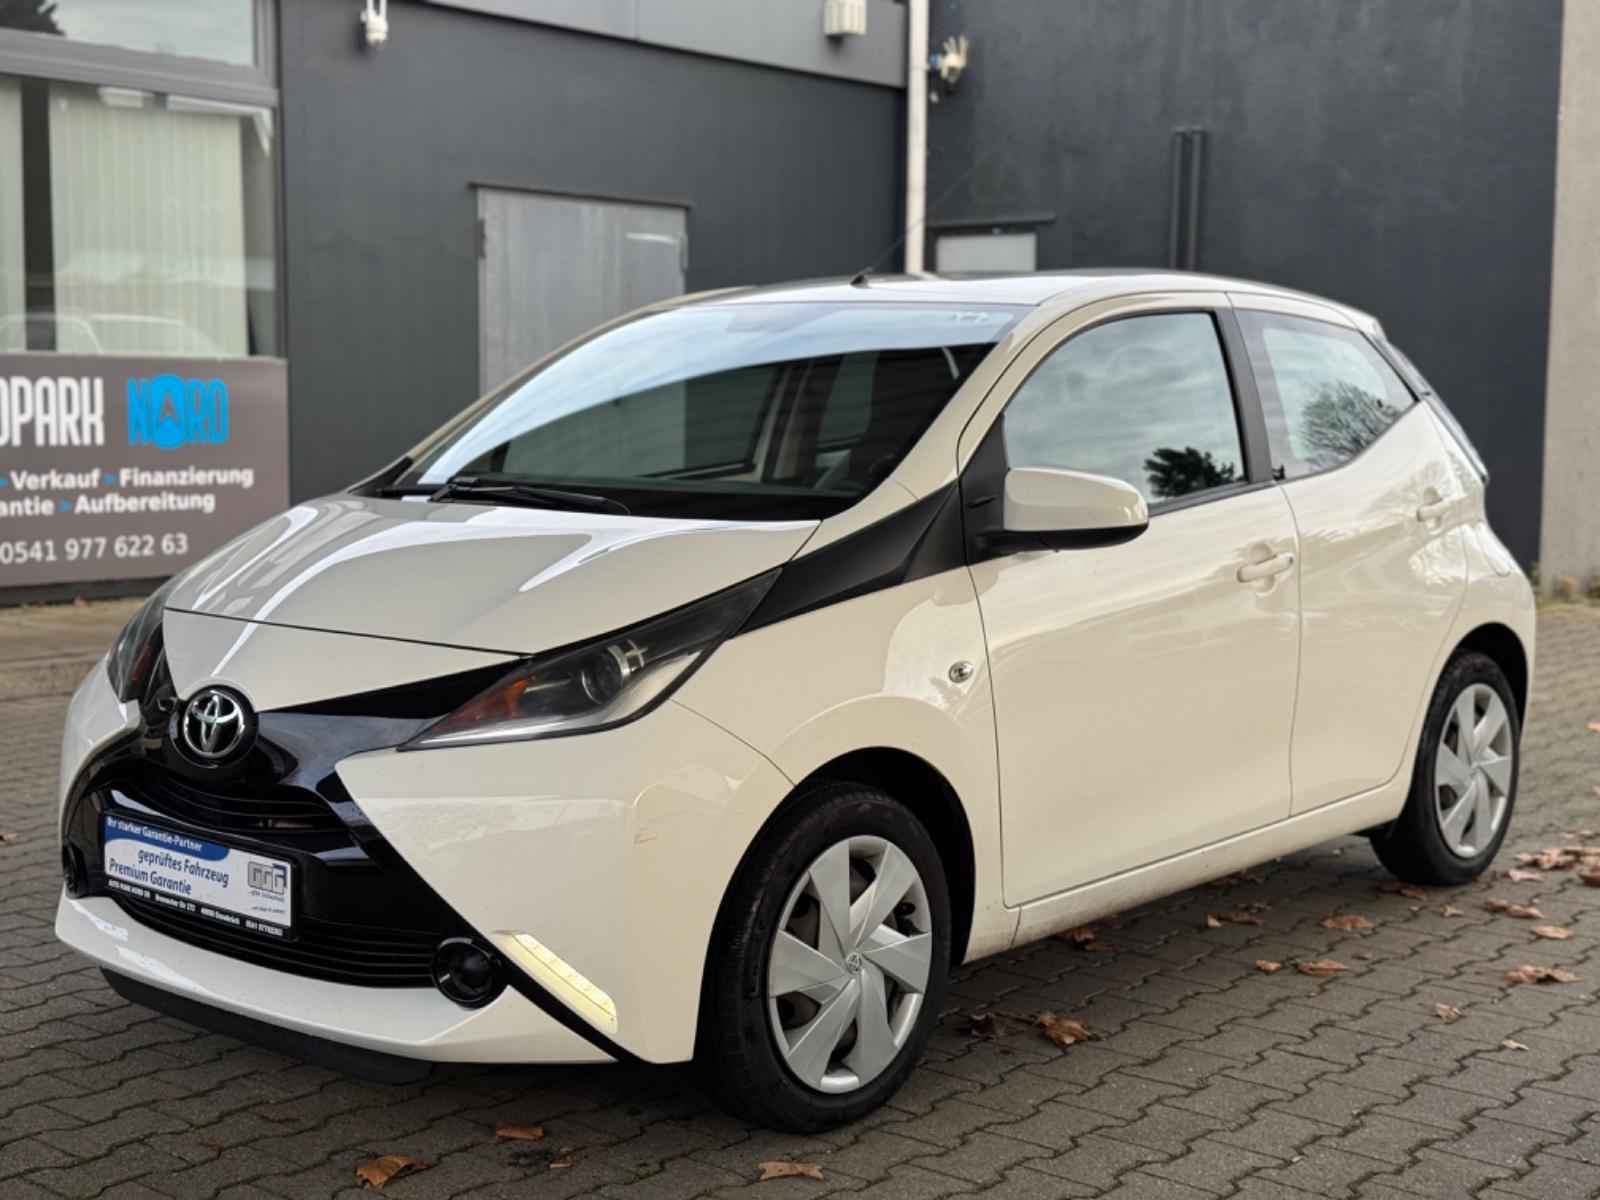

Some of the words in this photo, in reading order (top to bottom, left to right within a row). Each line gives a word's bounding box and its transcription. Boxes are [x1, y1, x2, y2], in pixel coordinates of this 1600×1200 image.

[127, 373, 229, 449] NORD
[10, 469, 101, 490] Verkauf
[119, 465, 254, 489] Finanzierung
[74, 491, 215, 514] Aufbereitung
[0, 539, 57, 563] 0541
[65, 537, 107, 560] 977
[114, 534, 154, 557] 622
[161, 532, 188, 554] 63
[118, 820, 141, 834] starker
[143, 826, 203, 852] Garantie-Partner
[109, 858, 148, 882] Premium
[150, 871, 192, 895] Garantie
[138, 850, 182, 871] geprüftes
[184, 859, 229, 888] Fahrzeug
